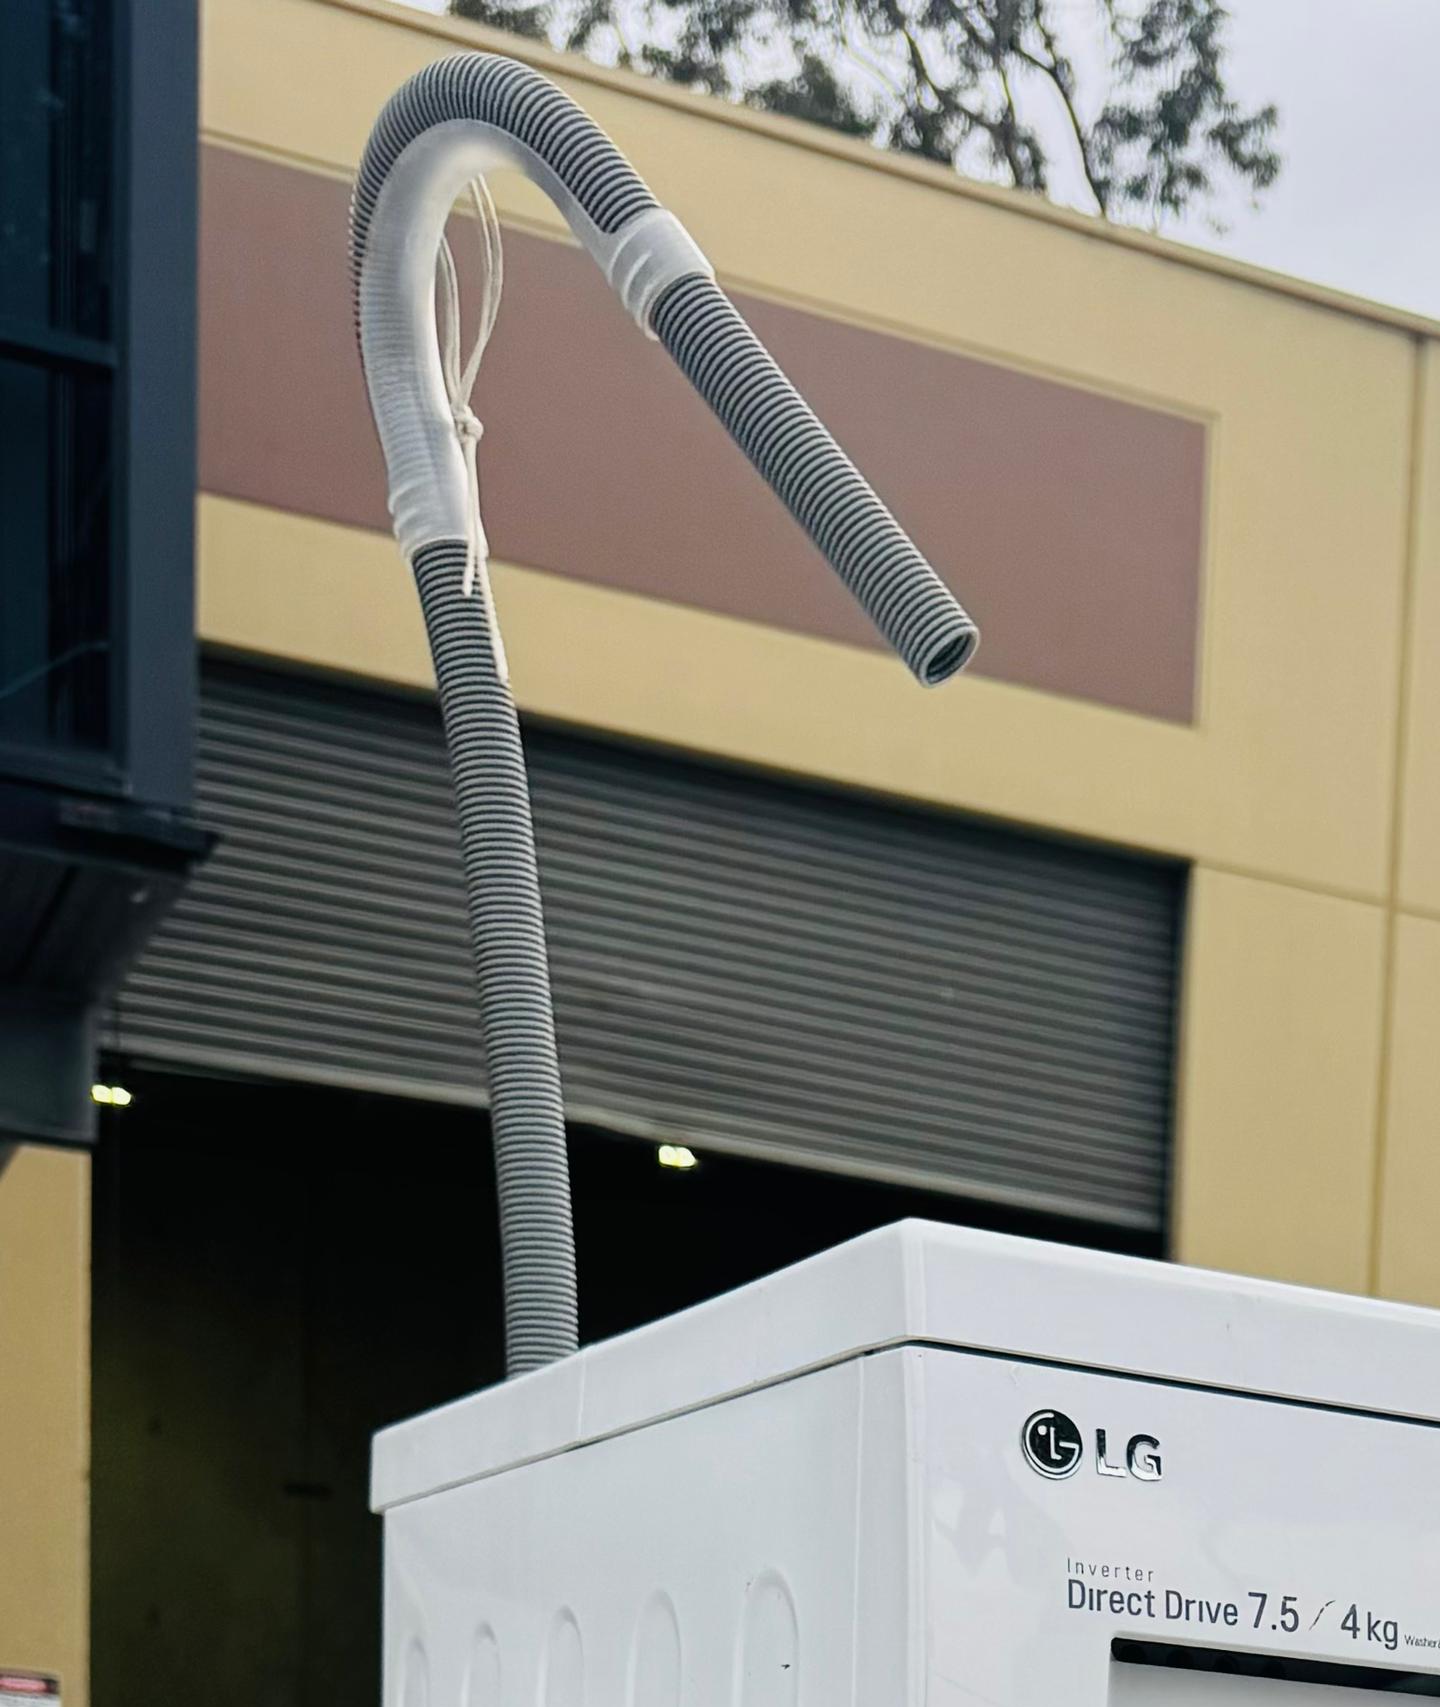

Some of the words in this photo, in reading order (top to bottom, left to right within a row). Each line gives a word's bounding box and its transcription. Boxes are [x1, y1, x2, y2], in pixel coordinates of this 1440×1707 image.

[1095, 1428, 1162, 1481] LG
[1067, 1557, 1155, 1583] Inverter
[1067, 1579, 1155, 1619] Direct
[1165, 1590, 1239, 1628] Drive
[1248, 1592, 1300, 1632] 7.5
